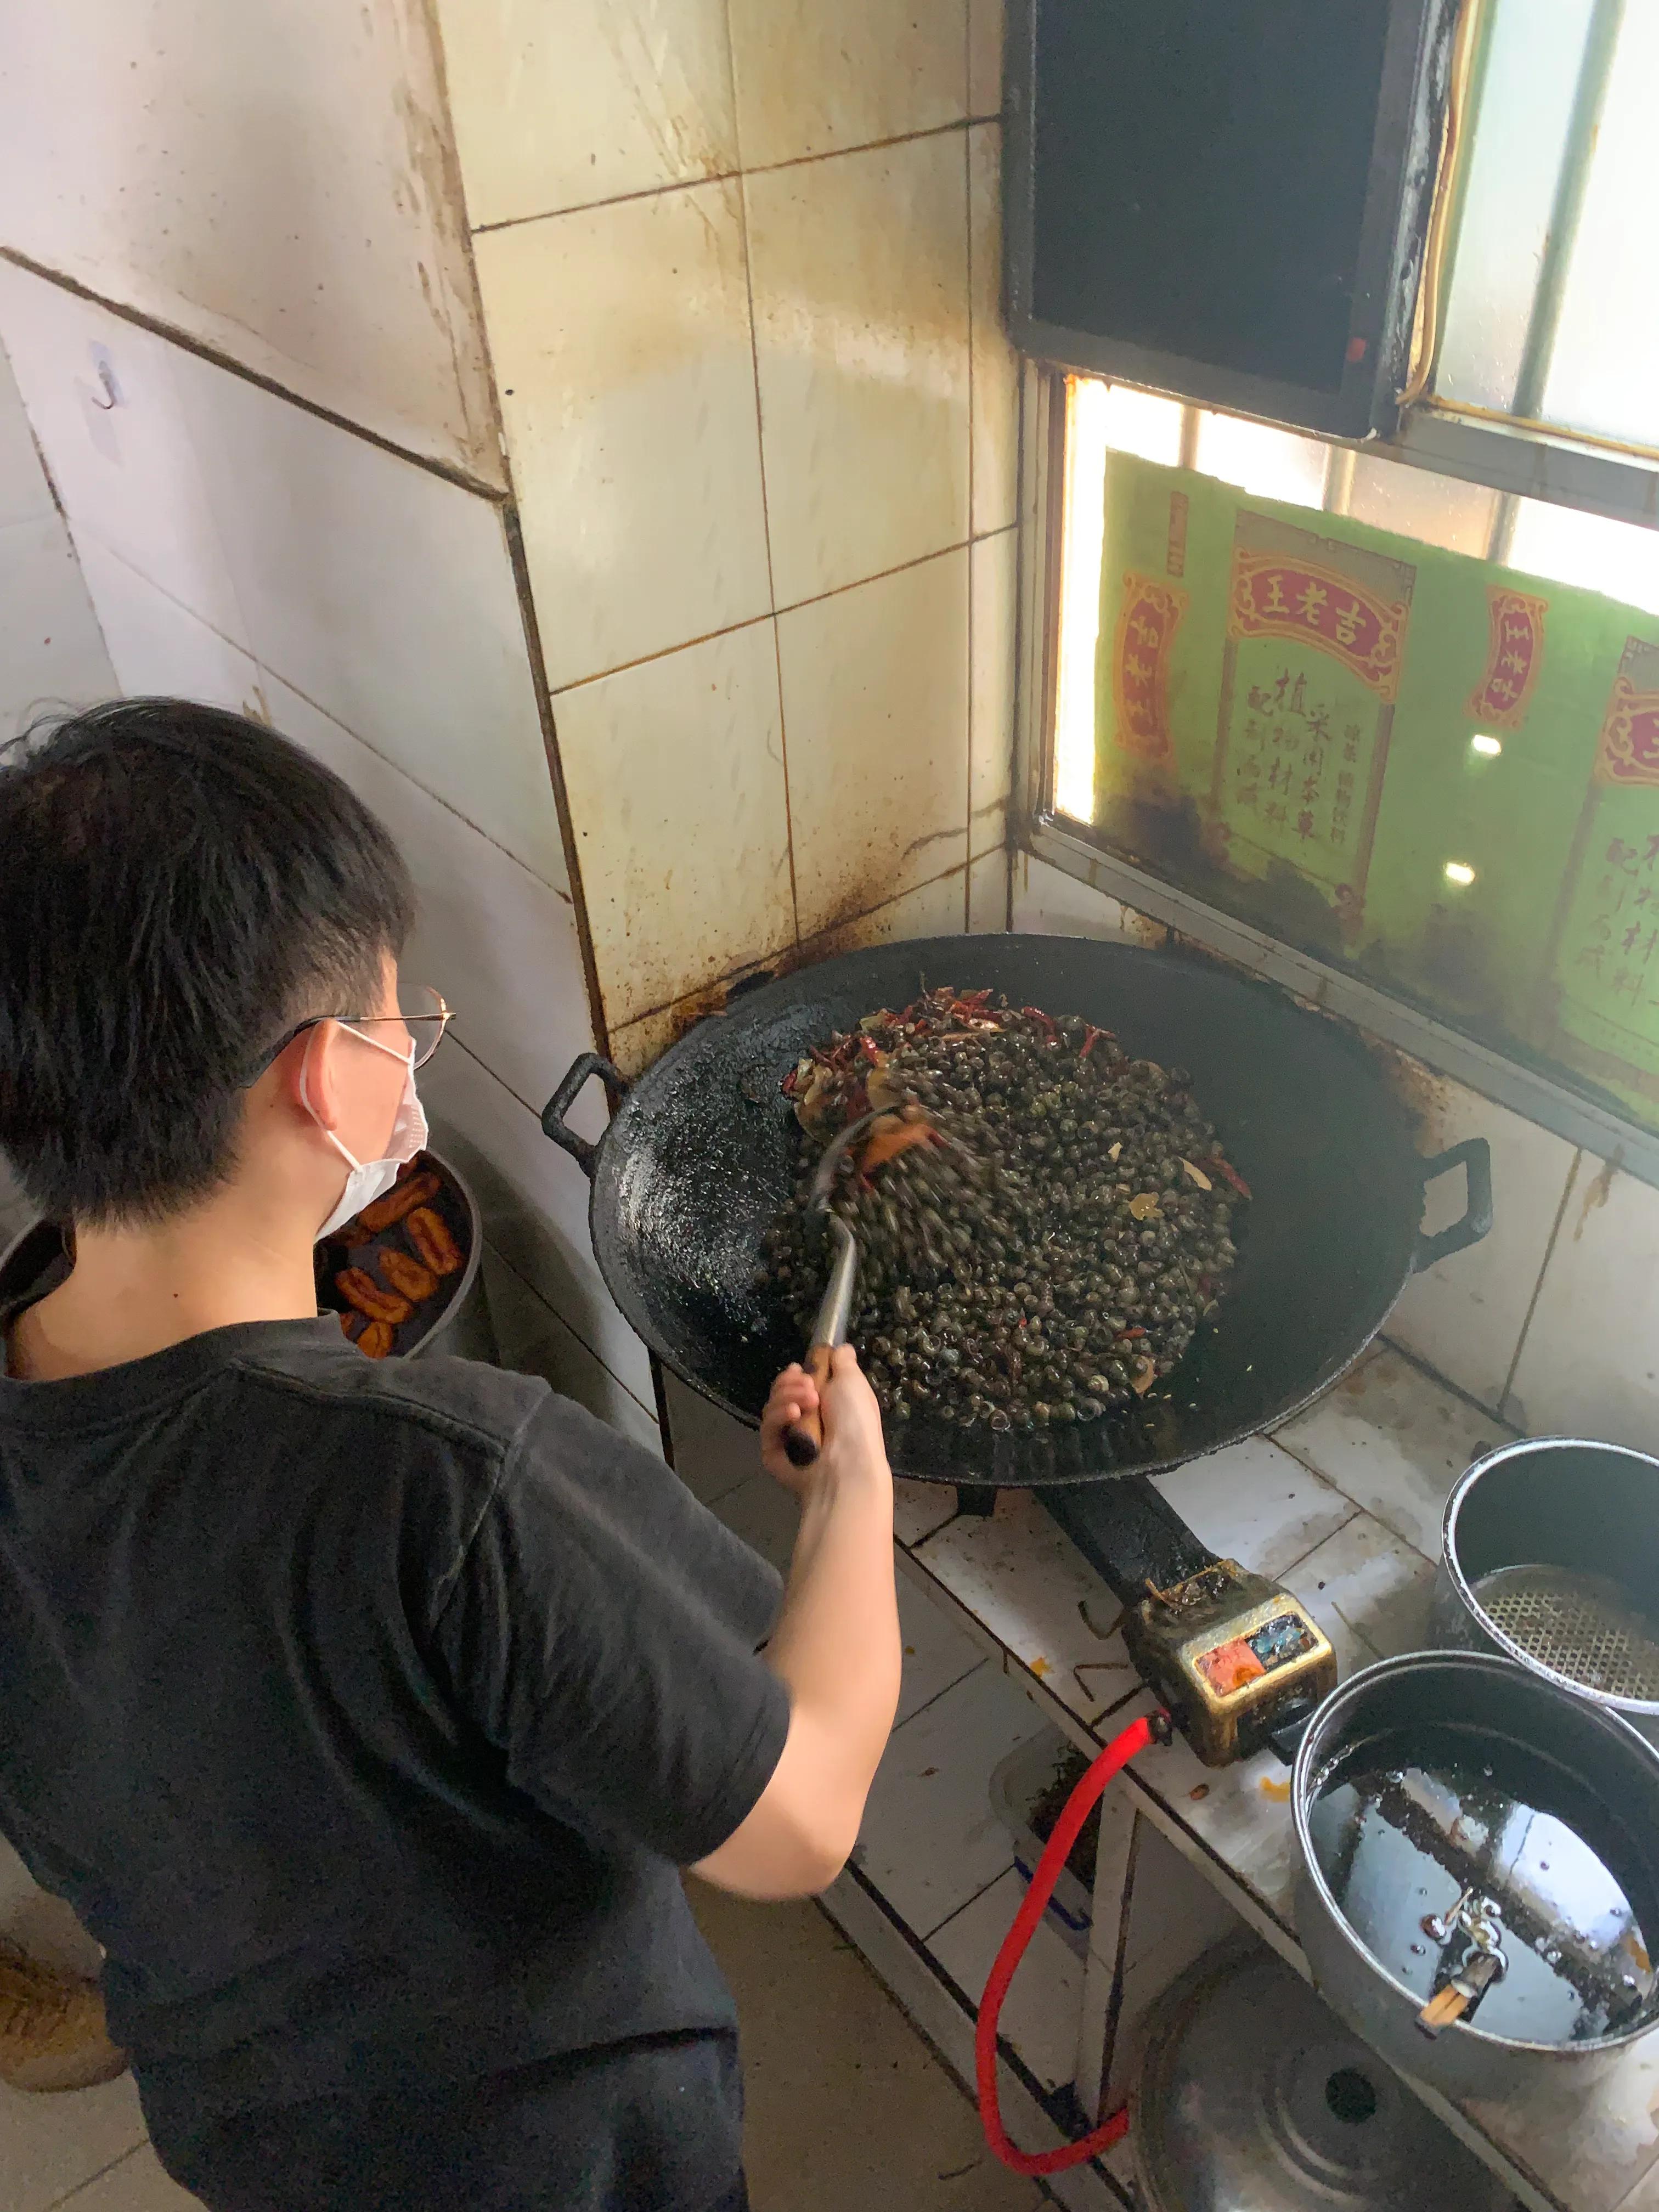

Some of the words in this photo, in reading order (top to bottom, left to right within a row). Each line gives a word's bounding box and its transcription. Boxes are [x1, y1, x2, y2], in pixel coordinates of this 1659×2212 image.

[1262, 574, 1366, 645] 王老吉
[1490, 620, 1530, 702] 王老吉
